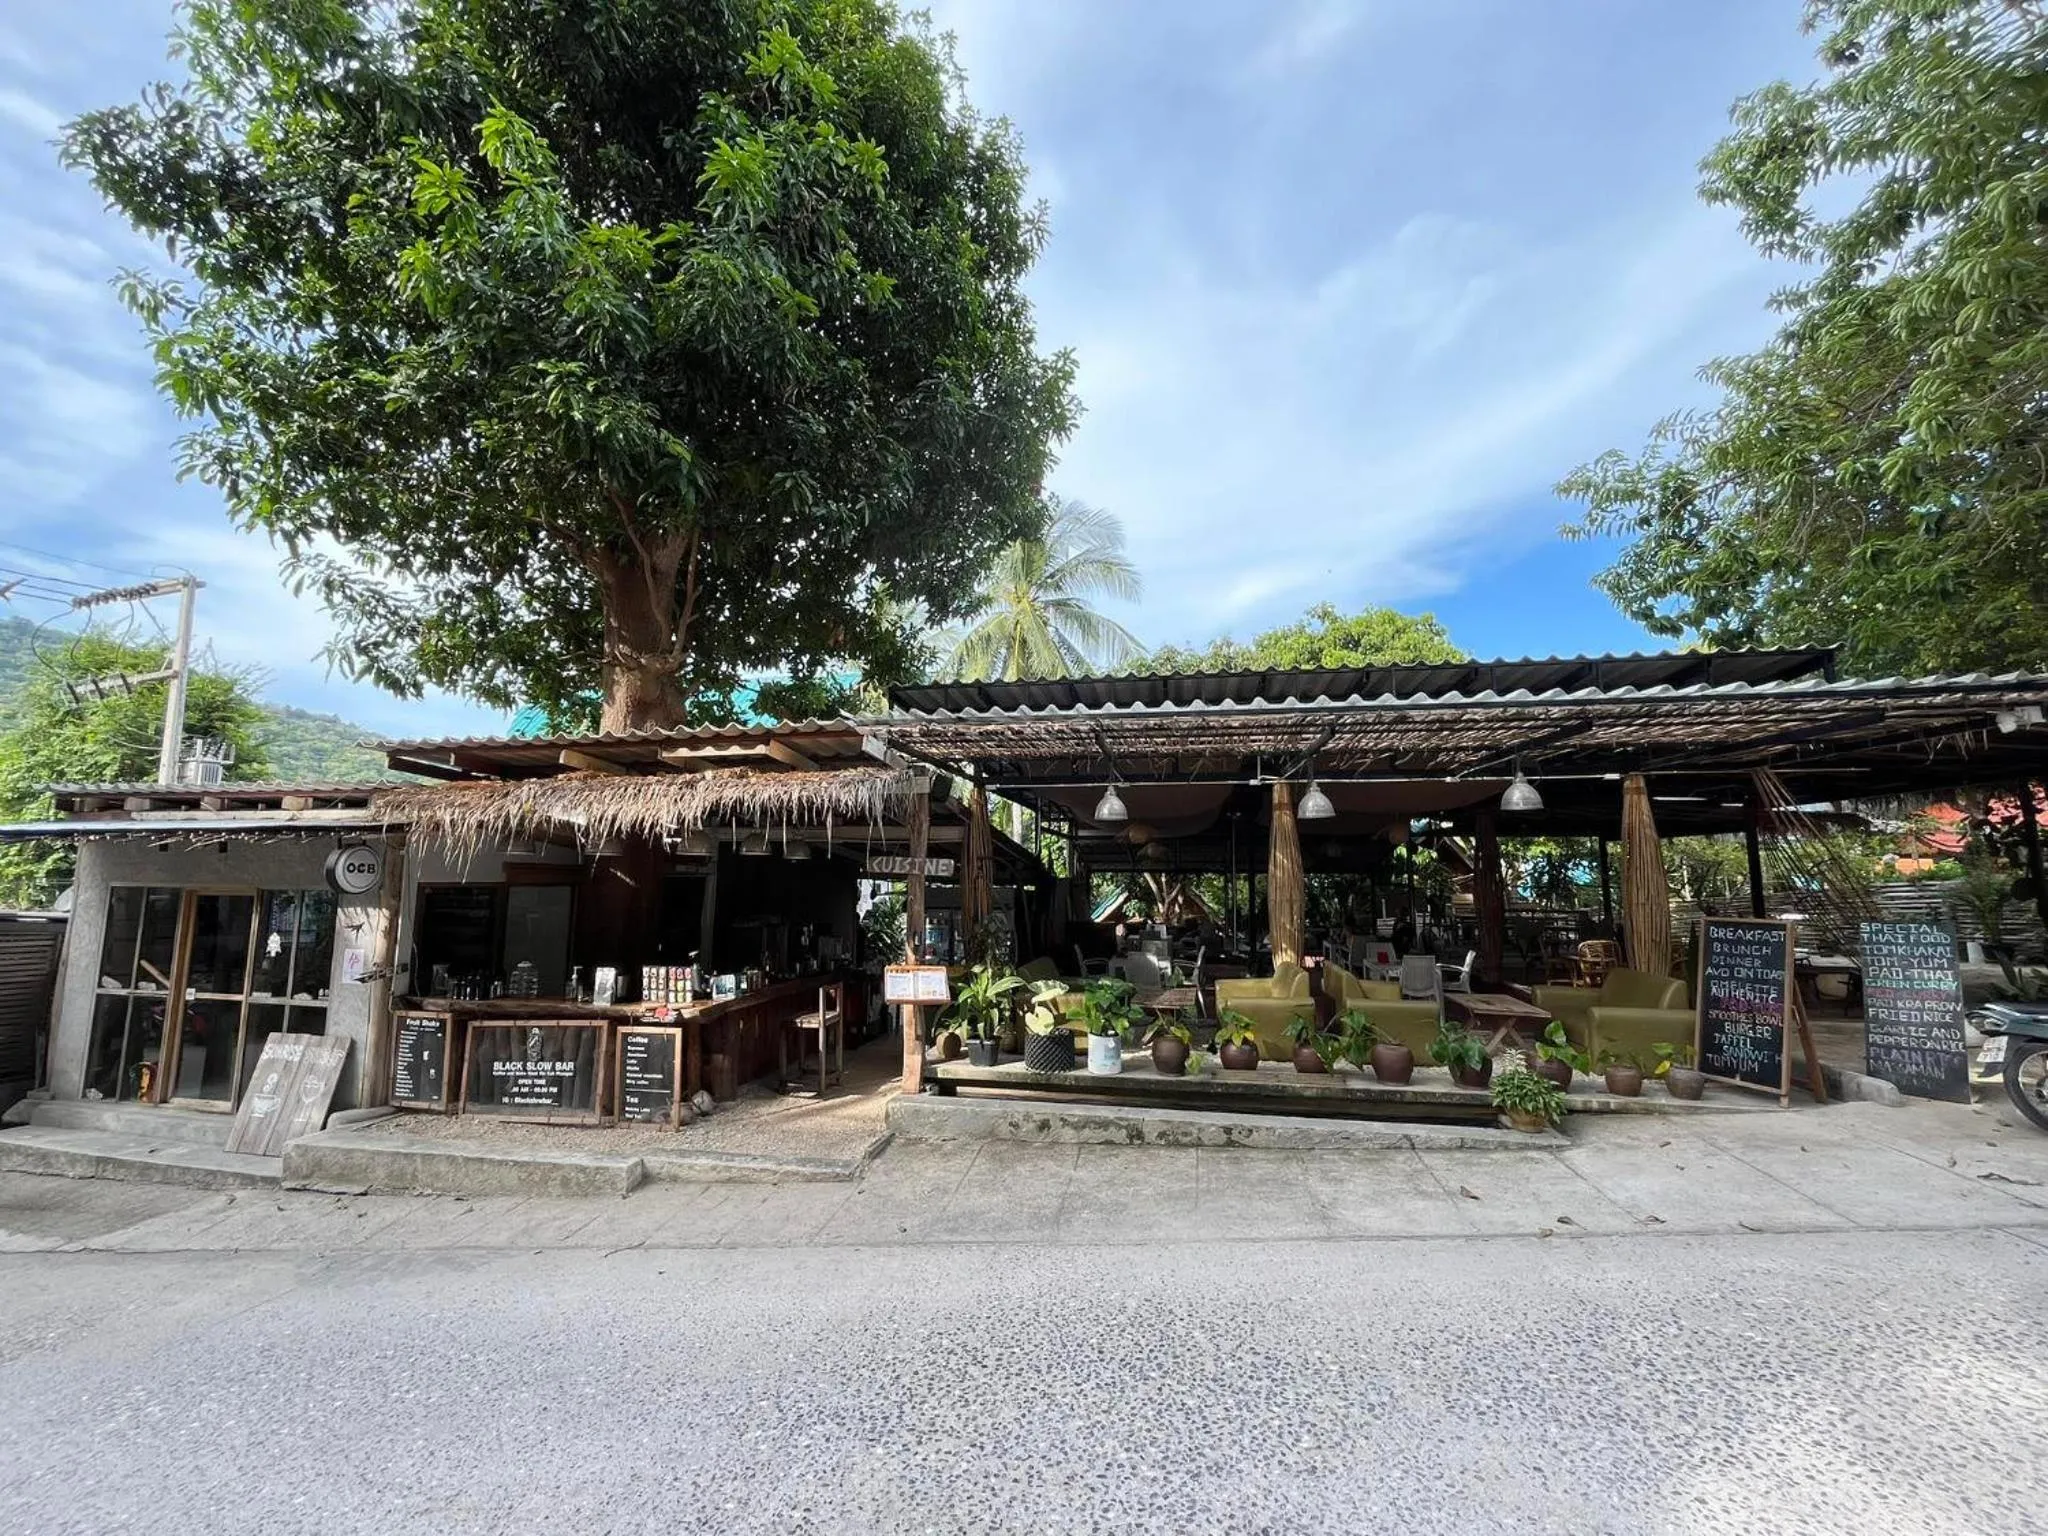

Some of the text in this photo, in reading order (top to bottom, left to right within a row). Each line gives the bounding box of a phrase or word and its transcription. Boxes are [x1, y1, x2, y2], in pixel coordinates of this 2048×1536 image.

[346, 862, 376, 874] OCB
[1709, 926, 1786, 942] BREAKFAST
[1860, 922, 1943, 935] SPECIAL
[1860, 933, 1951, 944] THAI FOOD
[1713, 941, 1772, 956] BRUNCH
[1711, 955, 1762, 967] DINNER
[1705, 966, 1730, 977] AVO
[1868, 1008, 1921, 1022] FRIED
[1724, 1021, 1772, 1040] BURGER
[1931, 1027, 1960, 1040] AND
[1722, 1045, 1784, 1064] SANDWIH
[493, 1061, 575, 1071] BLACK SLOW BAR
